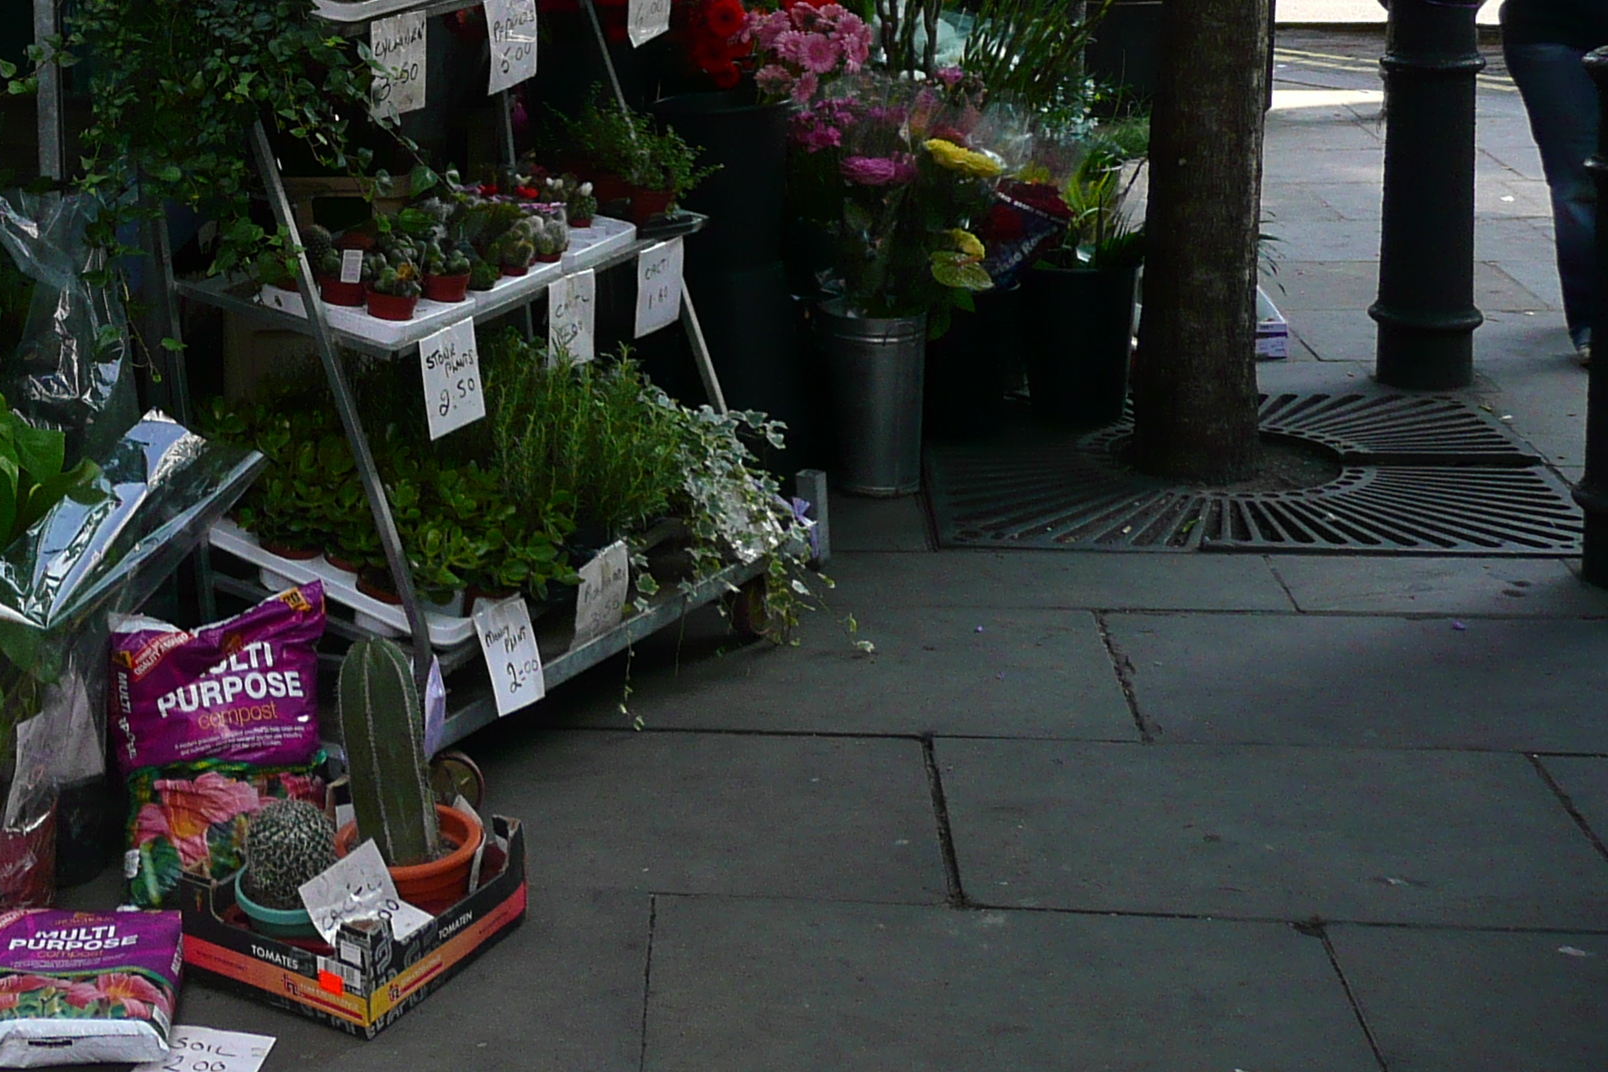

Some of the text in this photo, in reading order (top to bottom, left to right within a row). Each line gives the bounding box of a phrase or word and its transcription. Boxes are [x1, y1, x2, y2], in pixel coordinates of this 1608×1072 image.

[156, 671, 304, 719] PURPOSE
[198, 700, 278, 730] compost
[35, 925, 116, 941] MULTI
[438, 910, 473, 940] TOMATEN
[8, 934, 139, 951] PURPOSE
[36, 949, 104, 960] compost
[251, 944, 298, 970] TOMATES
[170, 1036, 236, 1058] SOIL
